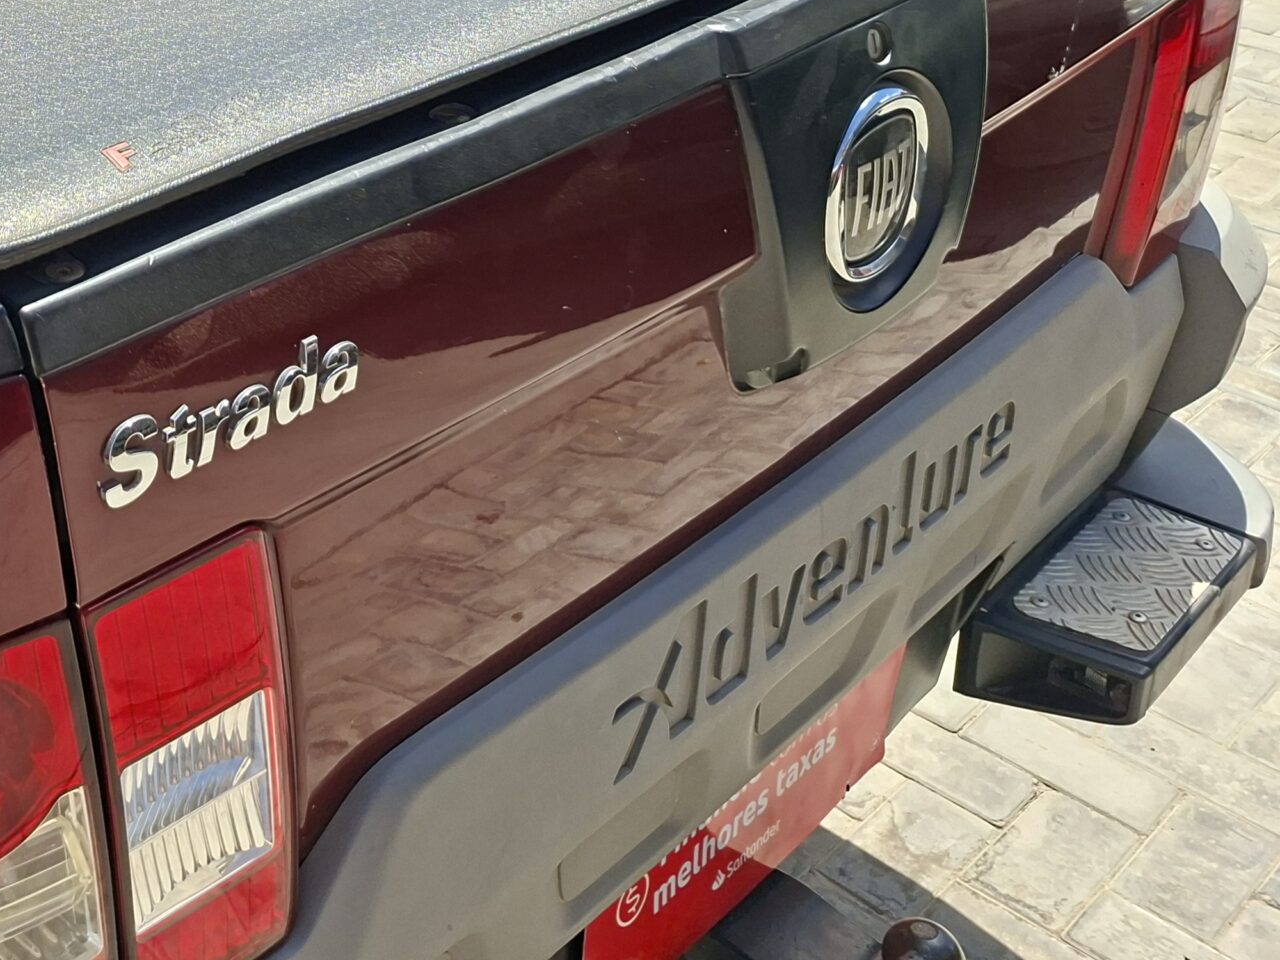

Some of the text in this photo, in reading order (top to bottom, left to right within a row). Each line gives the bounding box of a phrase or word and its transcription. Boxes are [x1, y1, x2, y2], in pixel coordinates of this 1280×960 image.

[851, 141, 912, 237] FIAT
[98, 335, 359, 509] Strada
[612, 401, 1015, 786] Adventure
[653, 787, 769, 915] melhores
[776, 727, 838, 797] taxas
[726, 819, 781, 878] Santander
